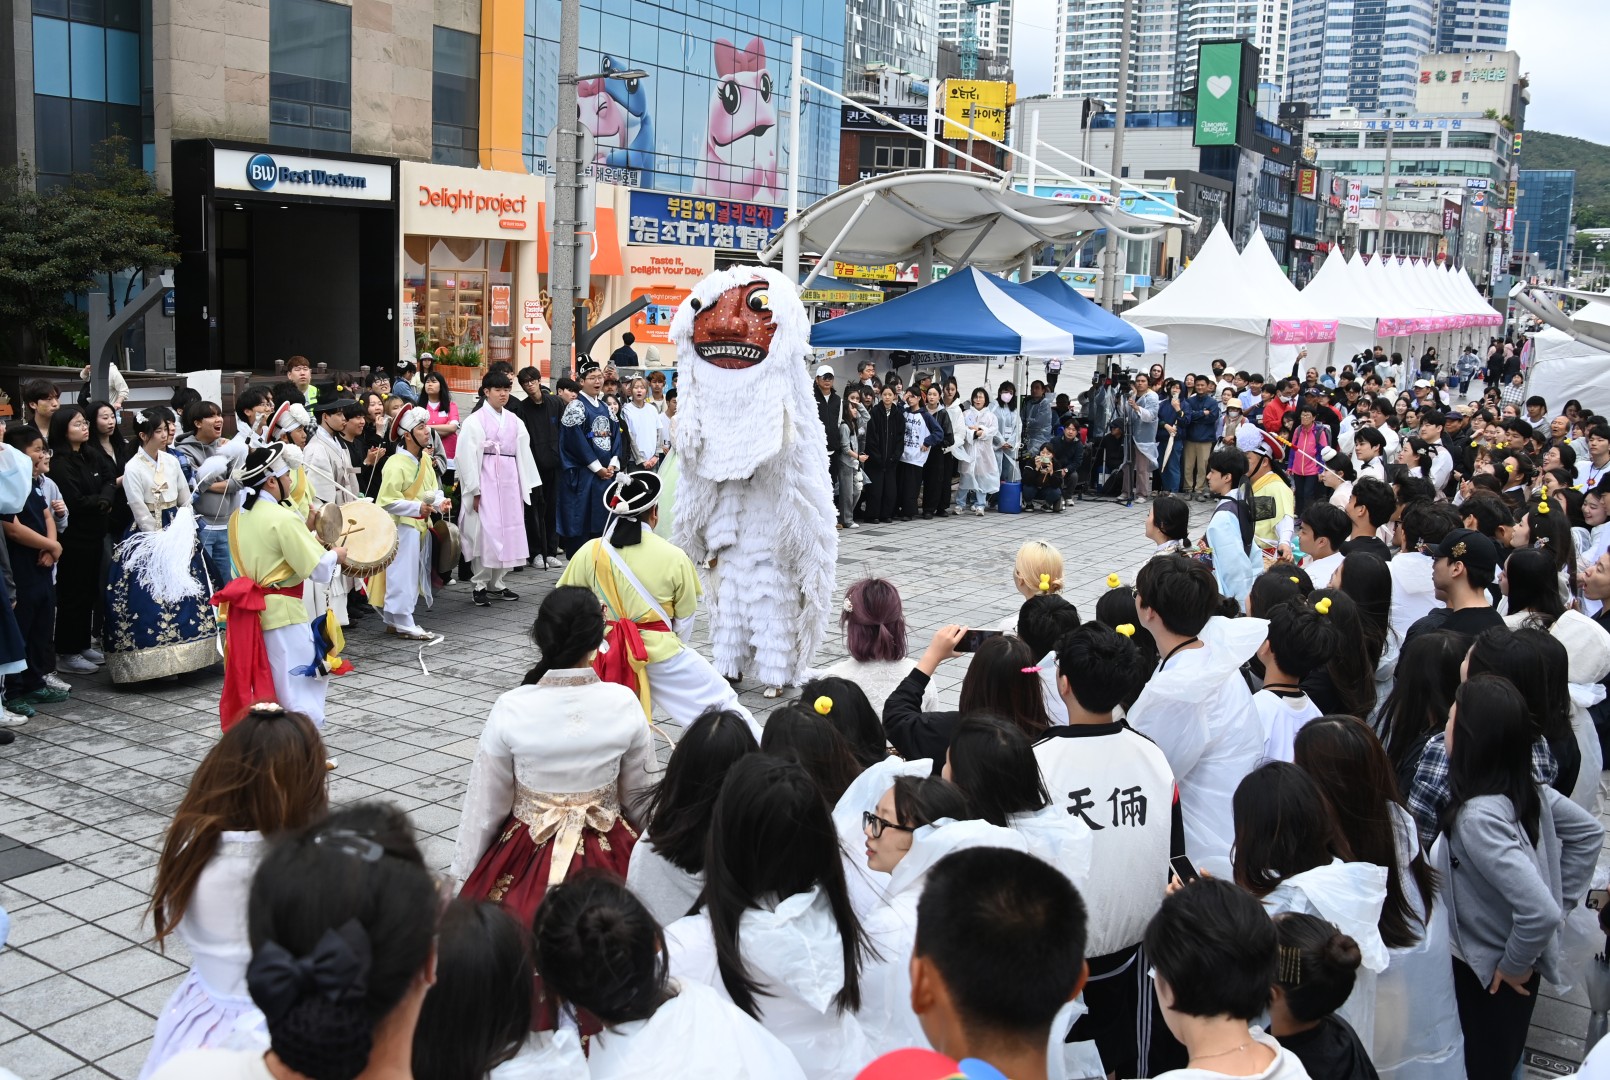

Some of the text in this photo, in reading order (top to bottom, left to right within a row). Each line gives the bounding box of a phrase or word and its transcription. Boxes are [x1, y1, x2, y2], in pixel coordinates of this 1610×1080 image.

[846, 110, 870, 123] 퀸즈
[252, 164, 275, 182] BW
[278, 166, 367, 189] Best Western
[596, 166, 638, 187] 해운대호텔
[1301, 170, 1312, 193] BAR
[419, 185, 527, 217] Delight project
[631, 216, 658, 242] 황금
[661, 220, 710, 246] 조개구이
[650, 256, 674, 265] Taste
[835, 262, 855, 276] 황금
[630, 265, 704, 277] Delight Your Day.
